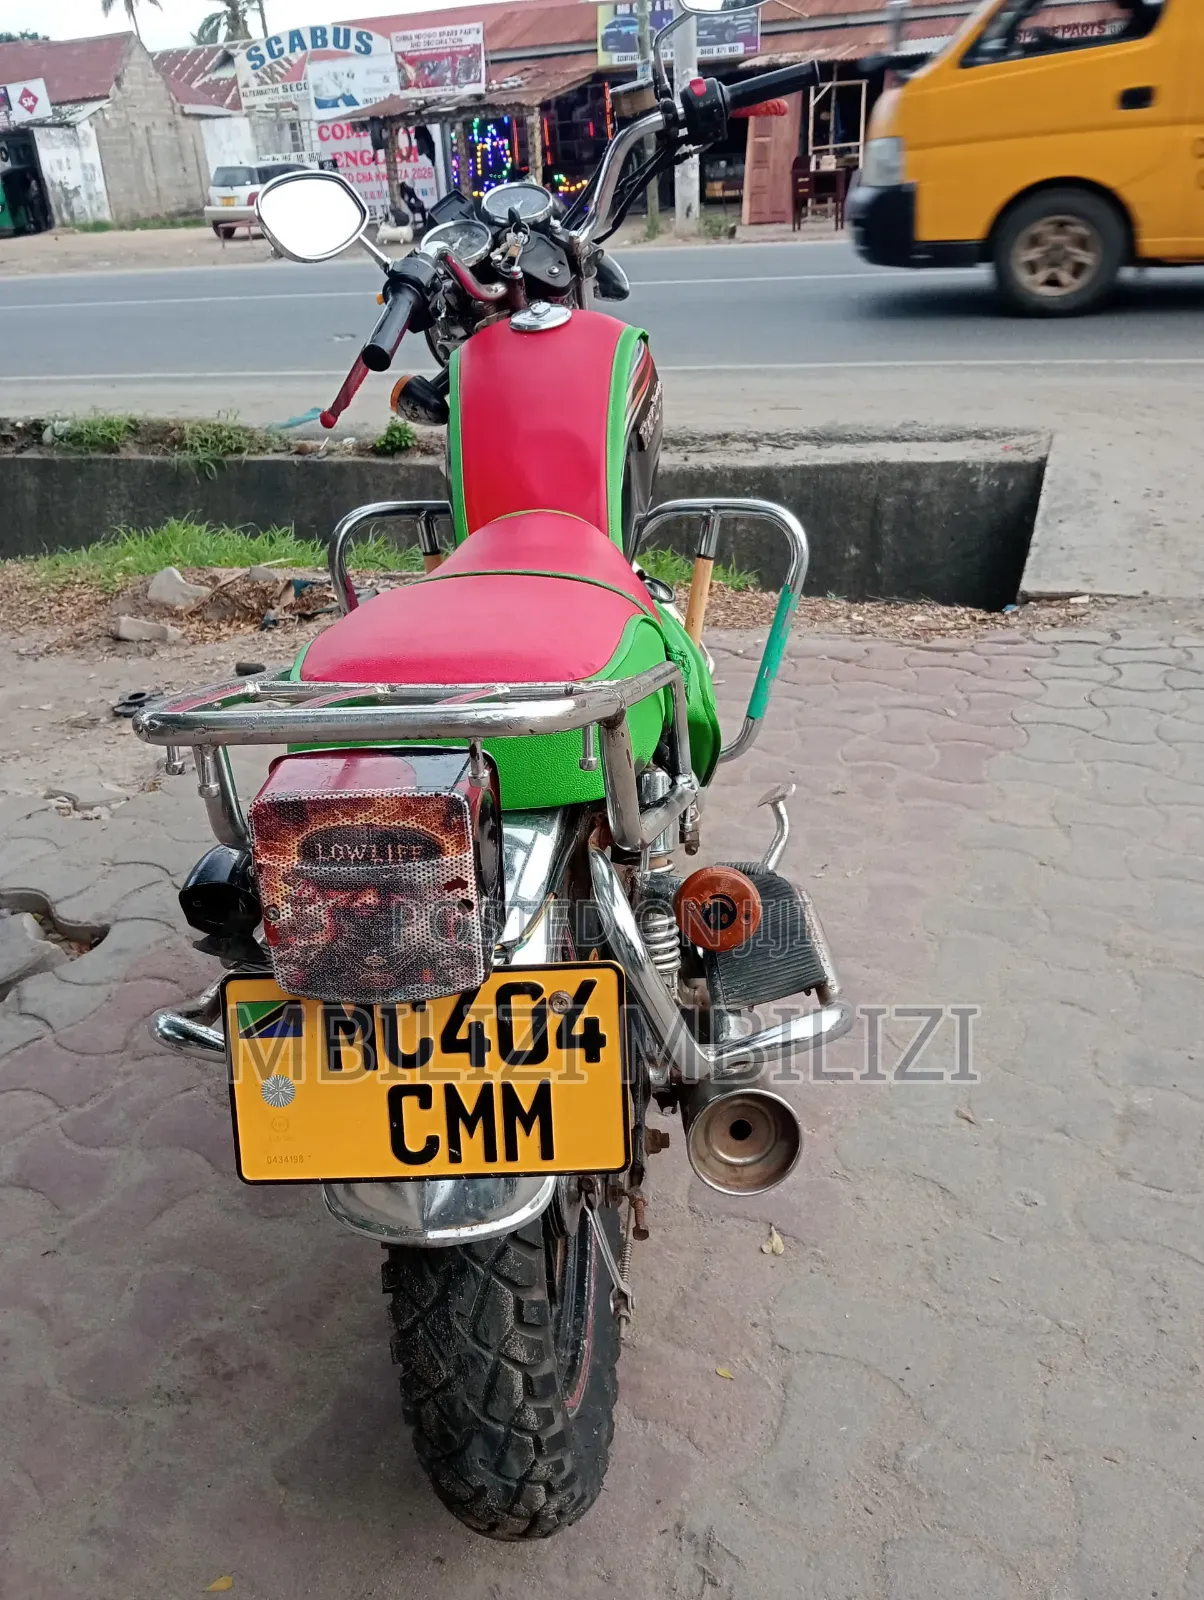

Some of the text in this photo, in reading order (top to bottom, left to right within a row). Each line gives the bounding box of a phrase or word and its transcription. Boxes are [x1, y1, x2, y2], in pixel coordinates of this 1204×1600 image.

[246, 26, 373, 70] SCABUS
[1062, 20, 1106, 38] PARTS
[387, 1079, 555, 1165] CMM
